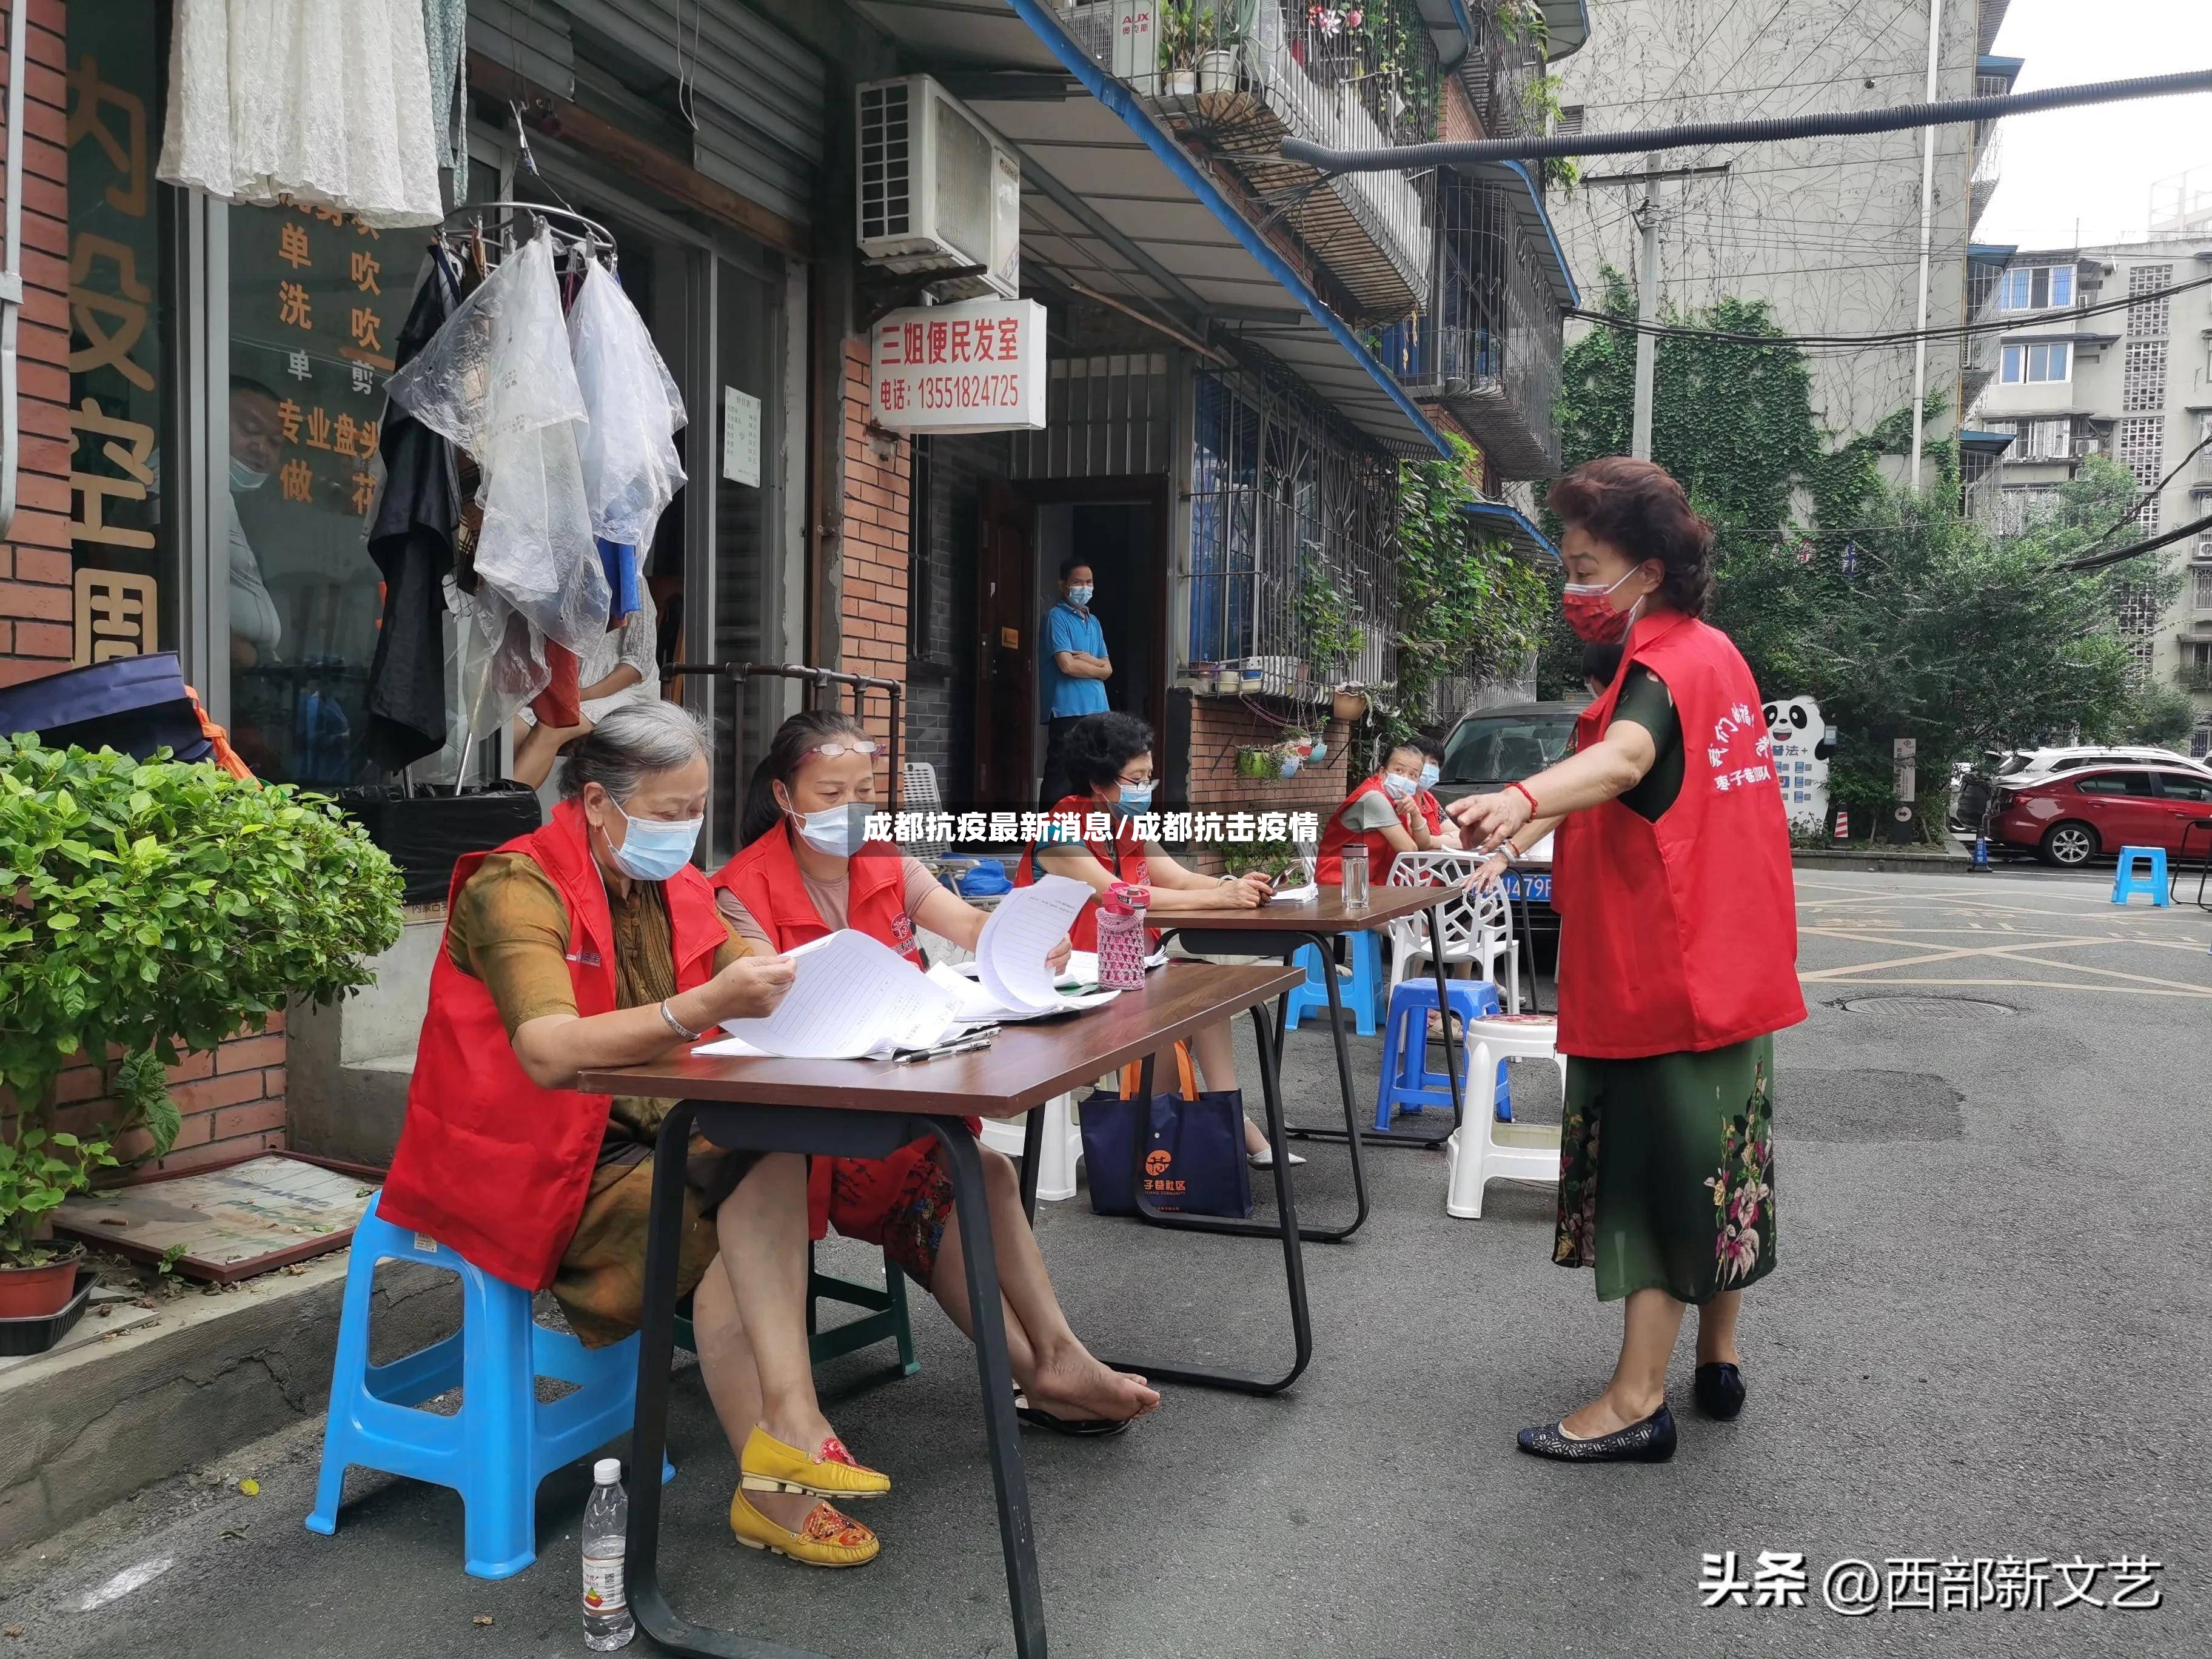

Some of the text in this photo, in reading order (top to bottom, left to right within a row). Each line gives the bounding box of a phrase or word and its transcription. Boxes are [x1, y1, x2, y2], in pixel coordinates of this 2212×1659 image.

[881, 317, 1018, 365] 三姐便民发室
[278, 398, 379, 459] 专业盘头
[1144, 1179, 1186, 1191] 子巷社区
